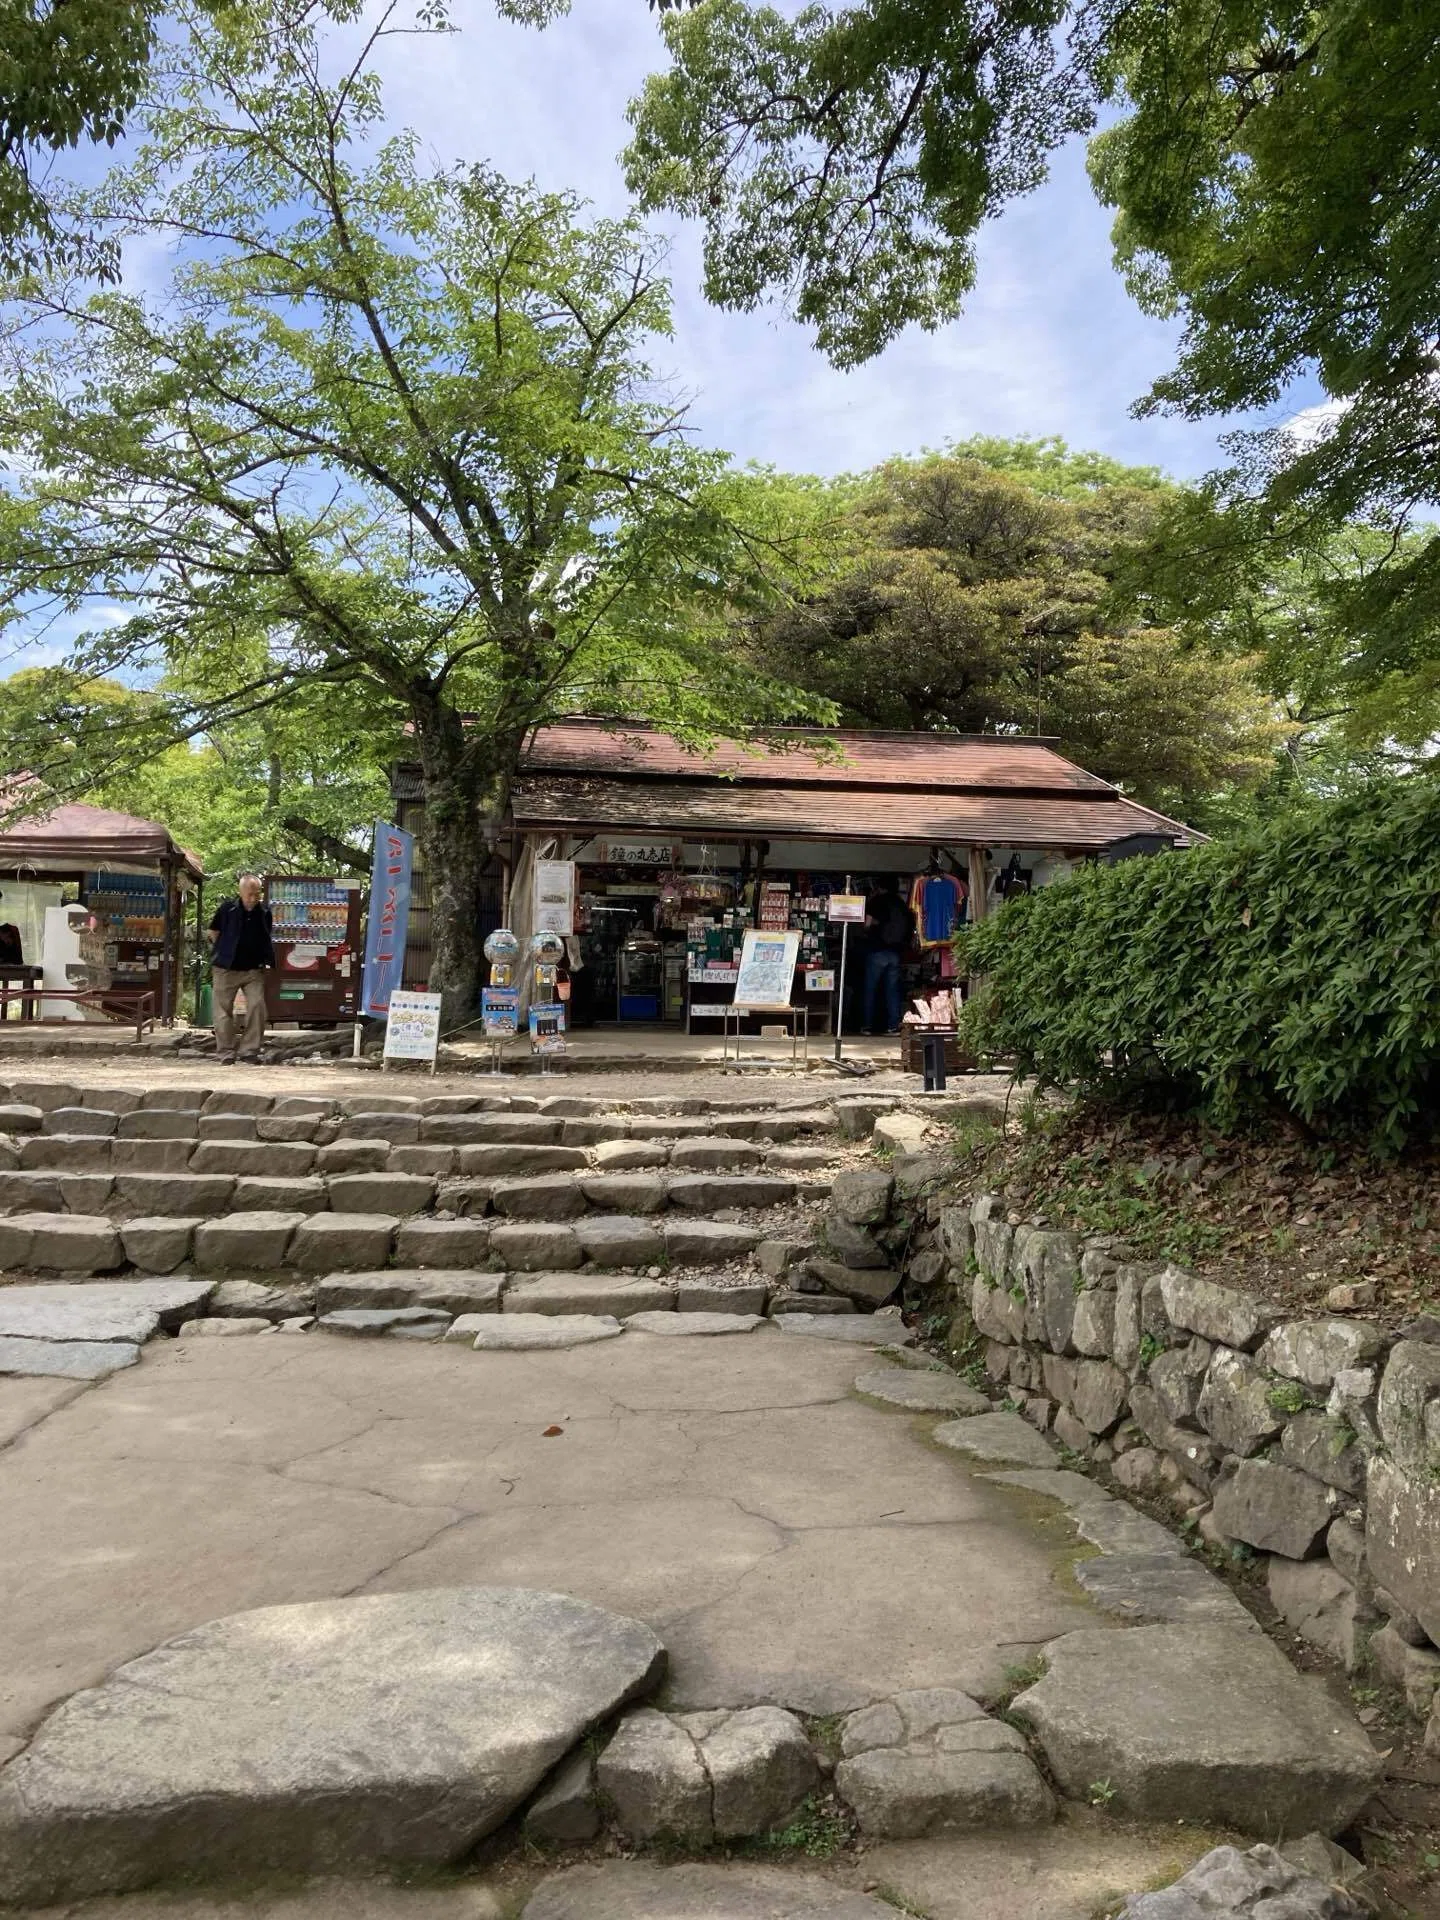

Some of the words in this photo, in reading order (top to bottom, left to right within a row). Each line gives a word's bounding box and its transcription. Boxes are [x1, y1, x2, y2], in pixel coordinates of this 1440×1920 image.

[609, 847, 670, 862] 鐘の丸売店
